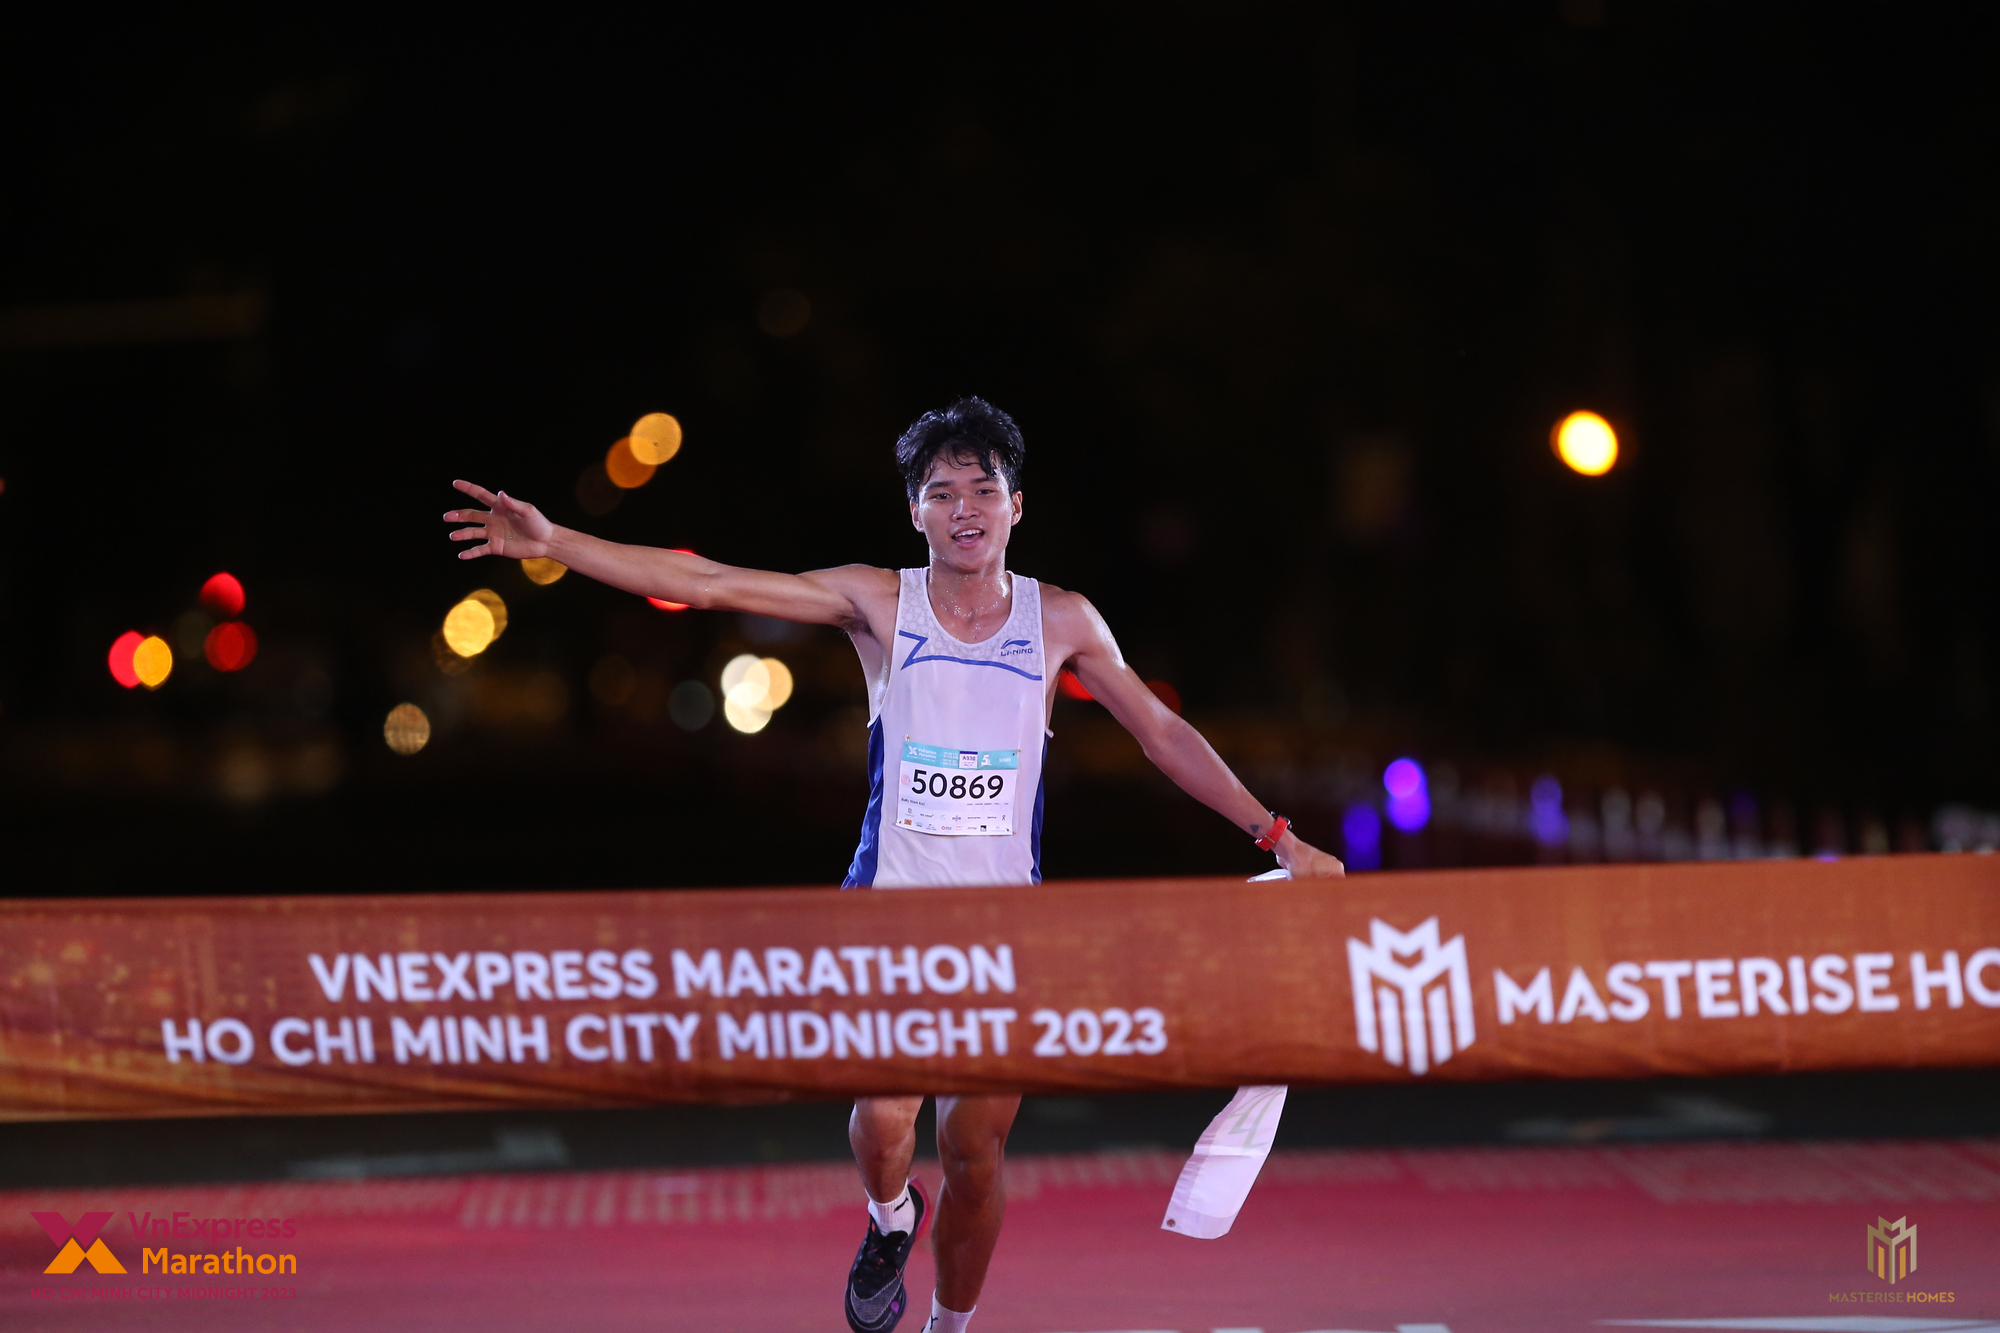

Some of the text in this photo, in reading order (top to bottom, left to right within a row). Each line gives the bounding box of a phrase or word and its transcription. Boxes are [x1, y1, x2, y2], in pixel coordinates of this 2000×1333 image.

[1001, 647, 1033, 657] LI-NING
[911, 769, 1004, 800] 50869
[308, 943, 1017, 1003] VNEXPRESS MARATHON
[1493, 953, 1900, 1024] MASTERISE
[161, 1006, 1168, 1066] HO CHI MINH CITY MIDNIGHT 2023
